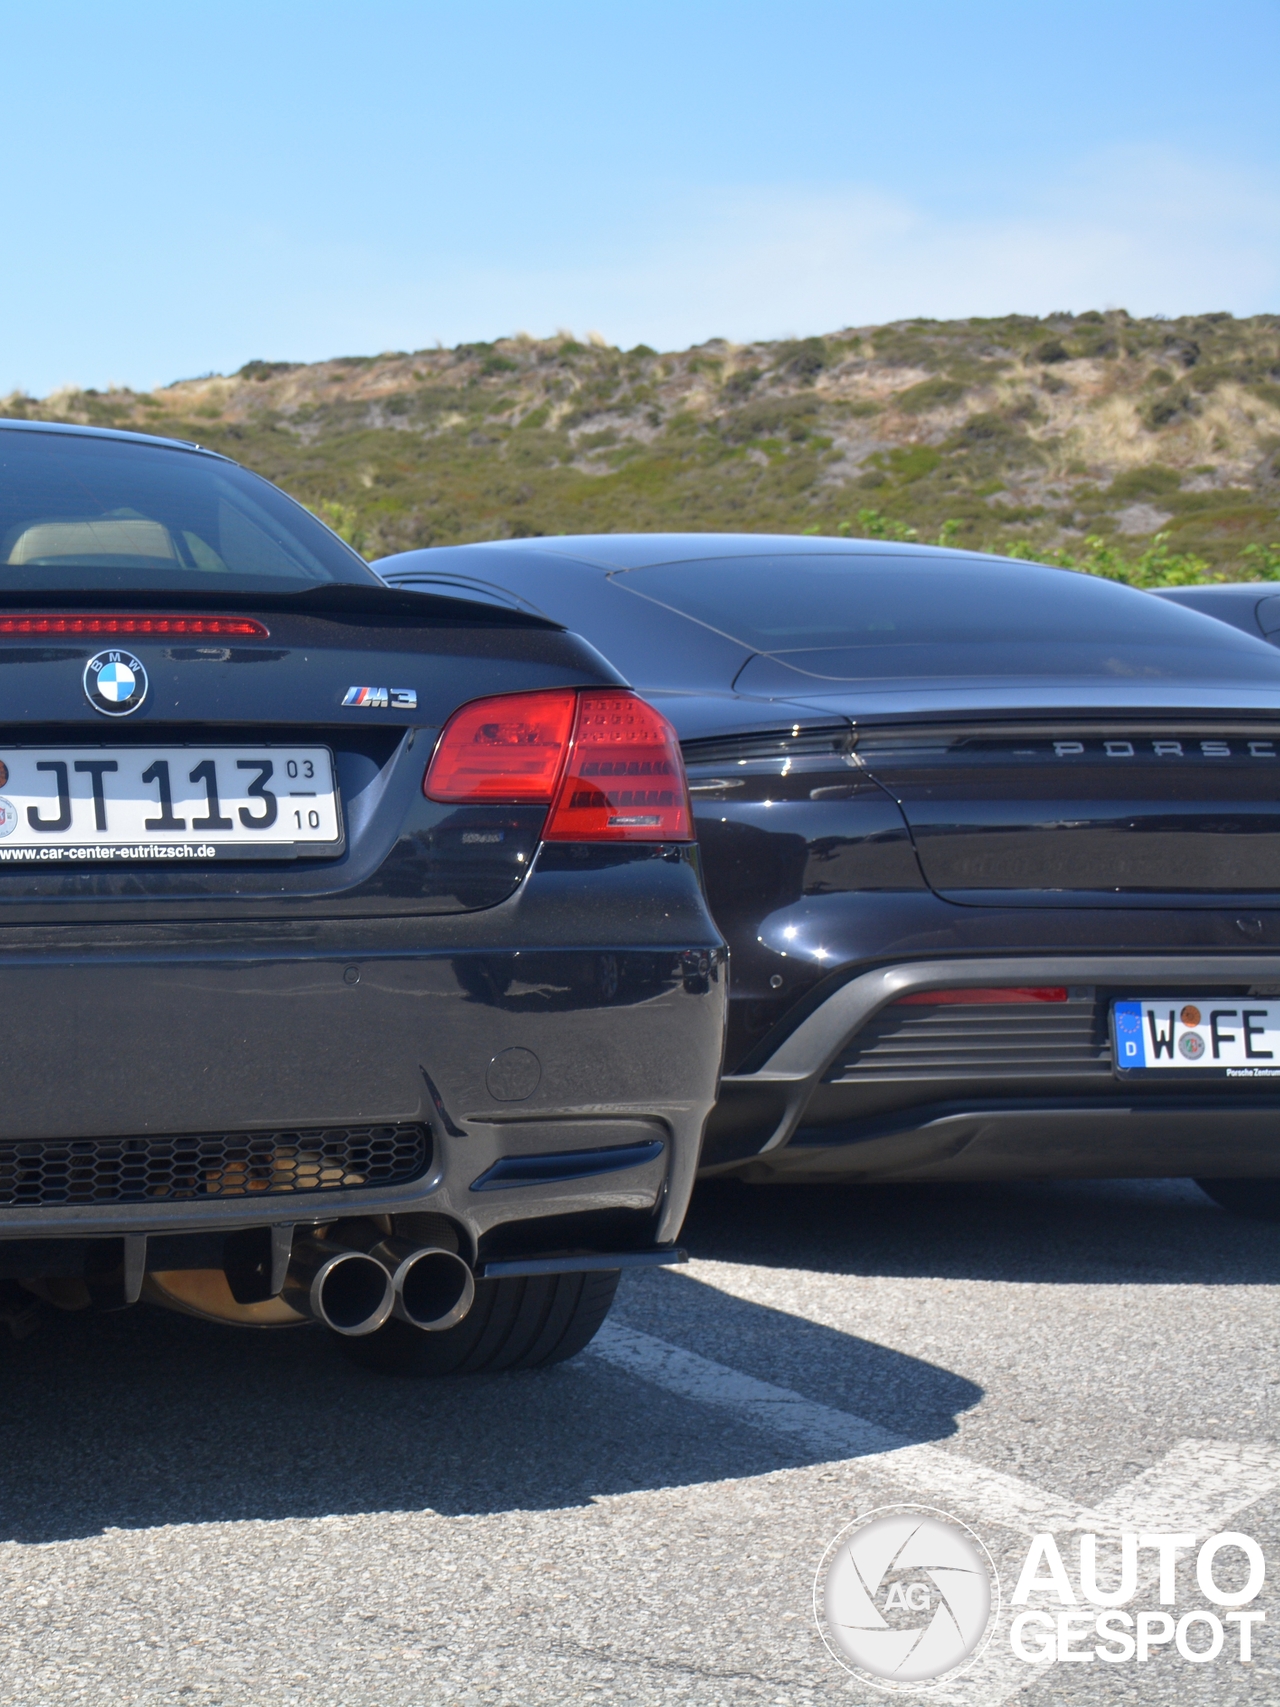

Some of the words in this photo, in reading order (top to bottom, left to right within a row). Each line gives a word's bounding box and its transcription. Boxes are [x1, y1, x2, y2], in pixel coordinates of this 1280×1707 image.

[90, 652, 141, 672] BMW
[358, 687, 418, 708] M3
[1053, 741, 1277, 757] PORSC
[286, 759, 316, 779] 03
[26, 760, 119, 832] JT
[141, 760, 279, 831] 113
[292, 809, 321, 830] 10
[0, 844, 216, 860] www.car-center-eutritzsch.de
[1147, 1010, 1176, 1059] W
[1210, 1010, 1274, 1059] FE
[1125, 1041, 1137, 1057] D
[1226, 1068, 1253, 1077] Porsche
